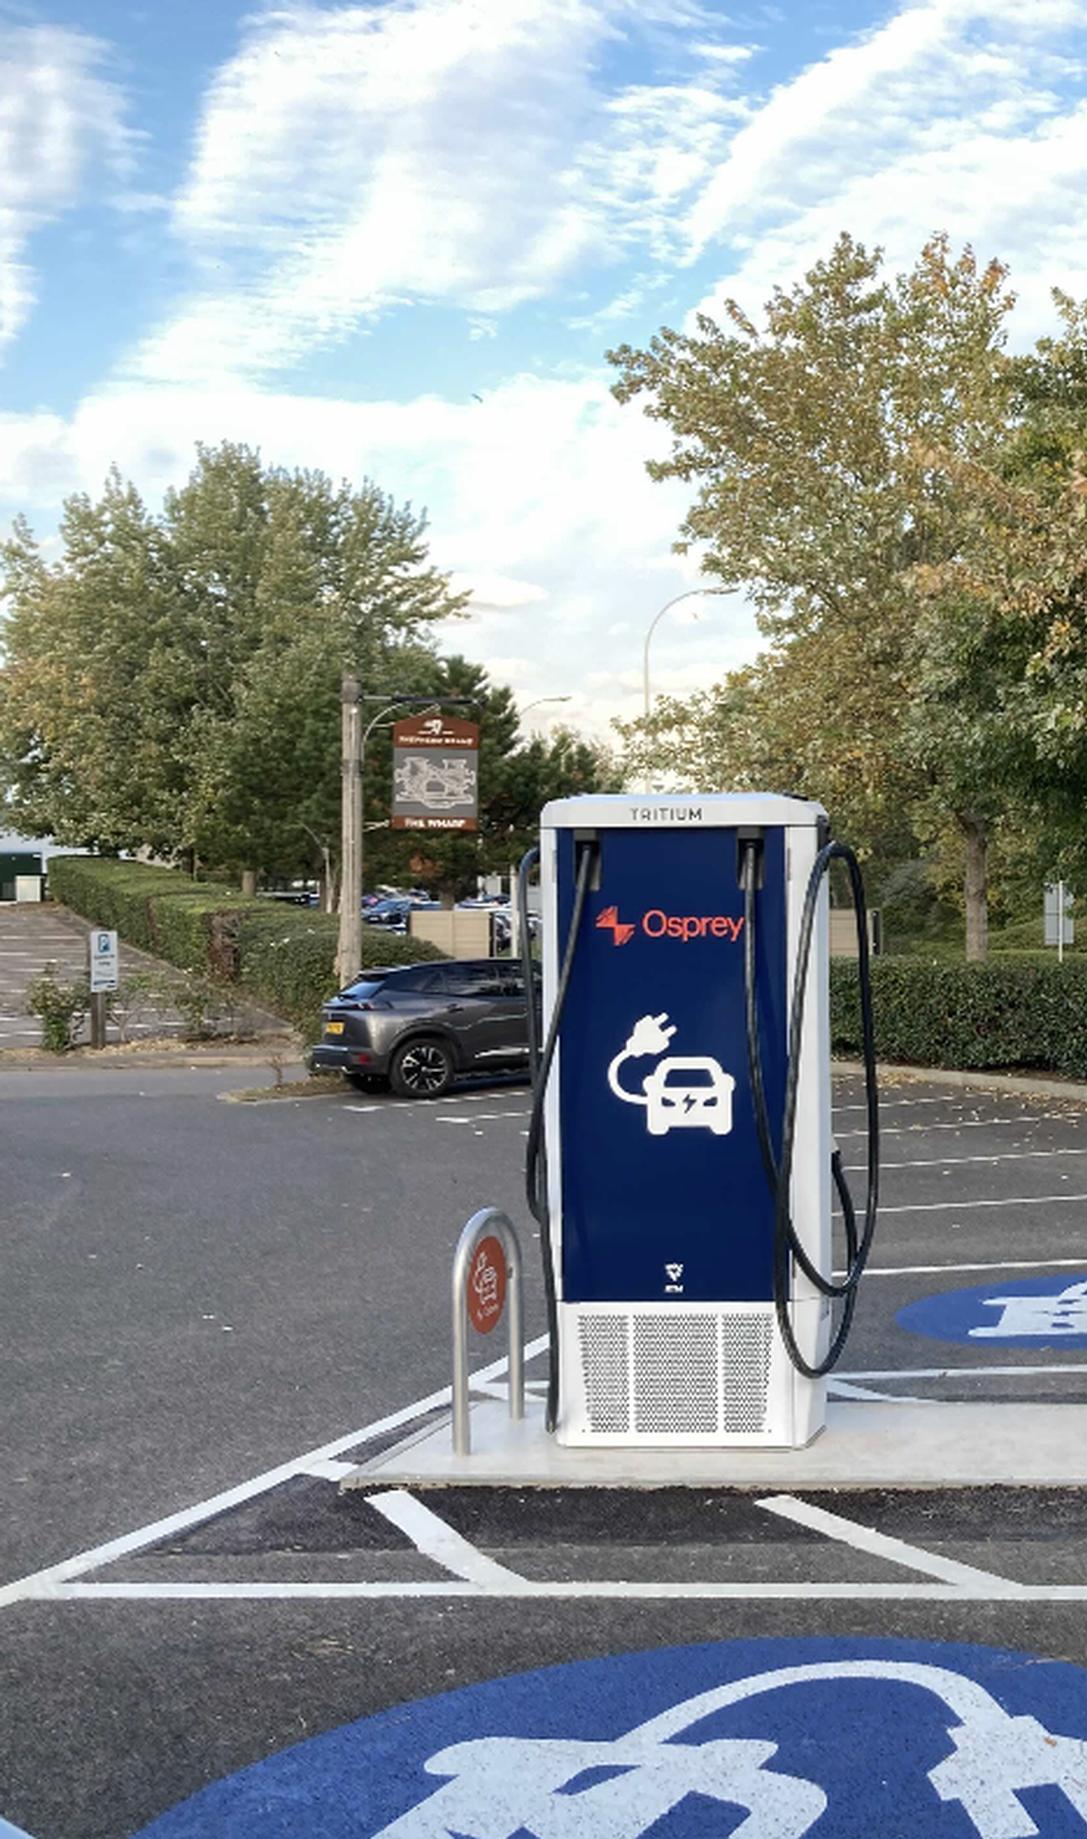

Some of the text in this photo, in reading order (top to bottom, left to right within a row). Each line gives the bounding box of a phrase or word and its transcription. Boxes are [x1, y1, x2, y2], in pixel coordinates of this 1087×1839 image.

[630, 807, 702, 821] TRITIUM
[404, 818, 467, 828] THE WHARF
[642, 909, 744, 942] Osprey
